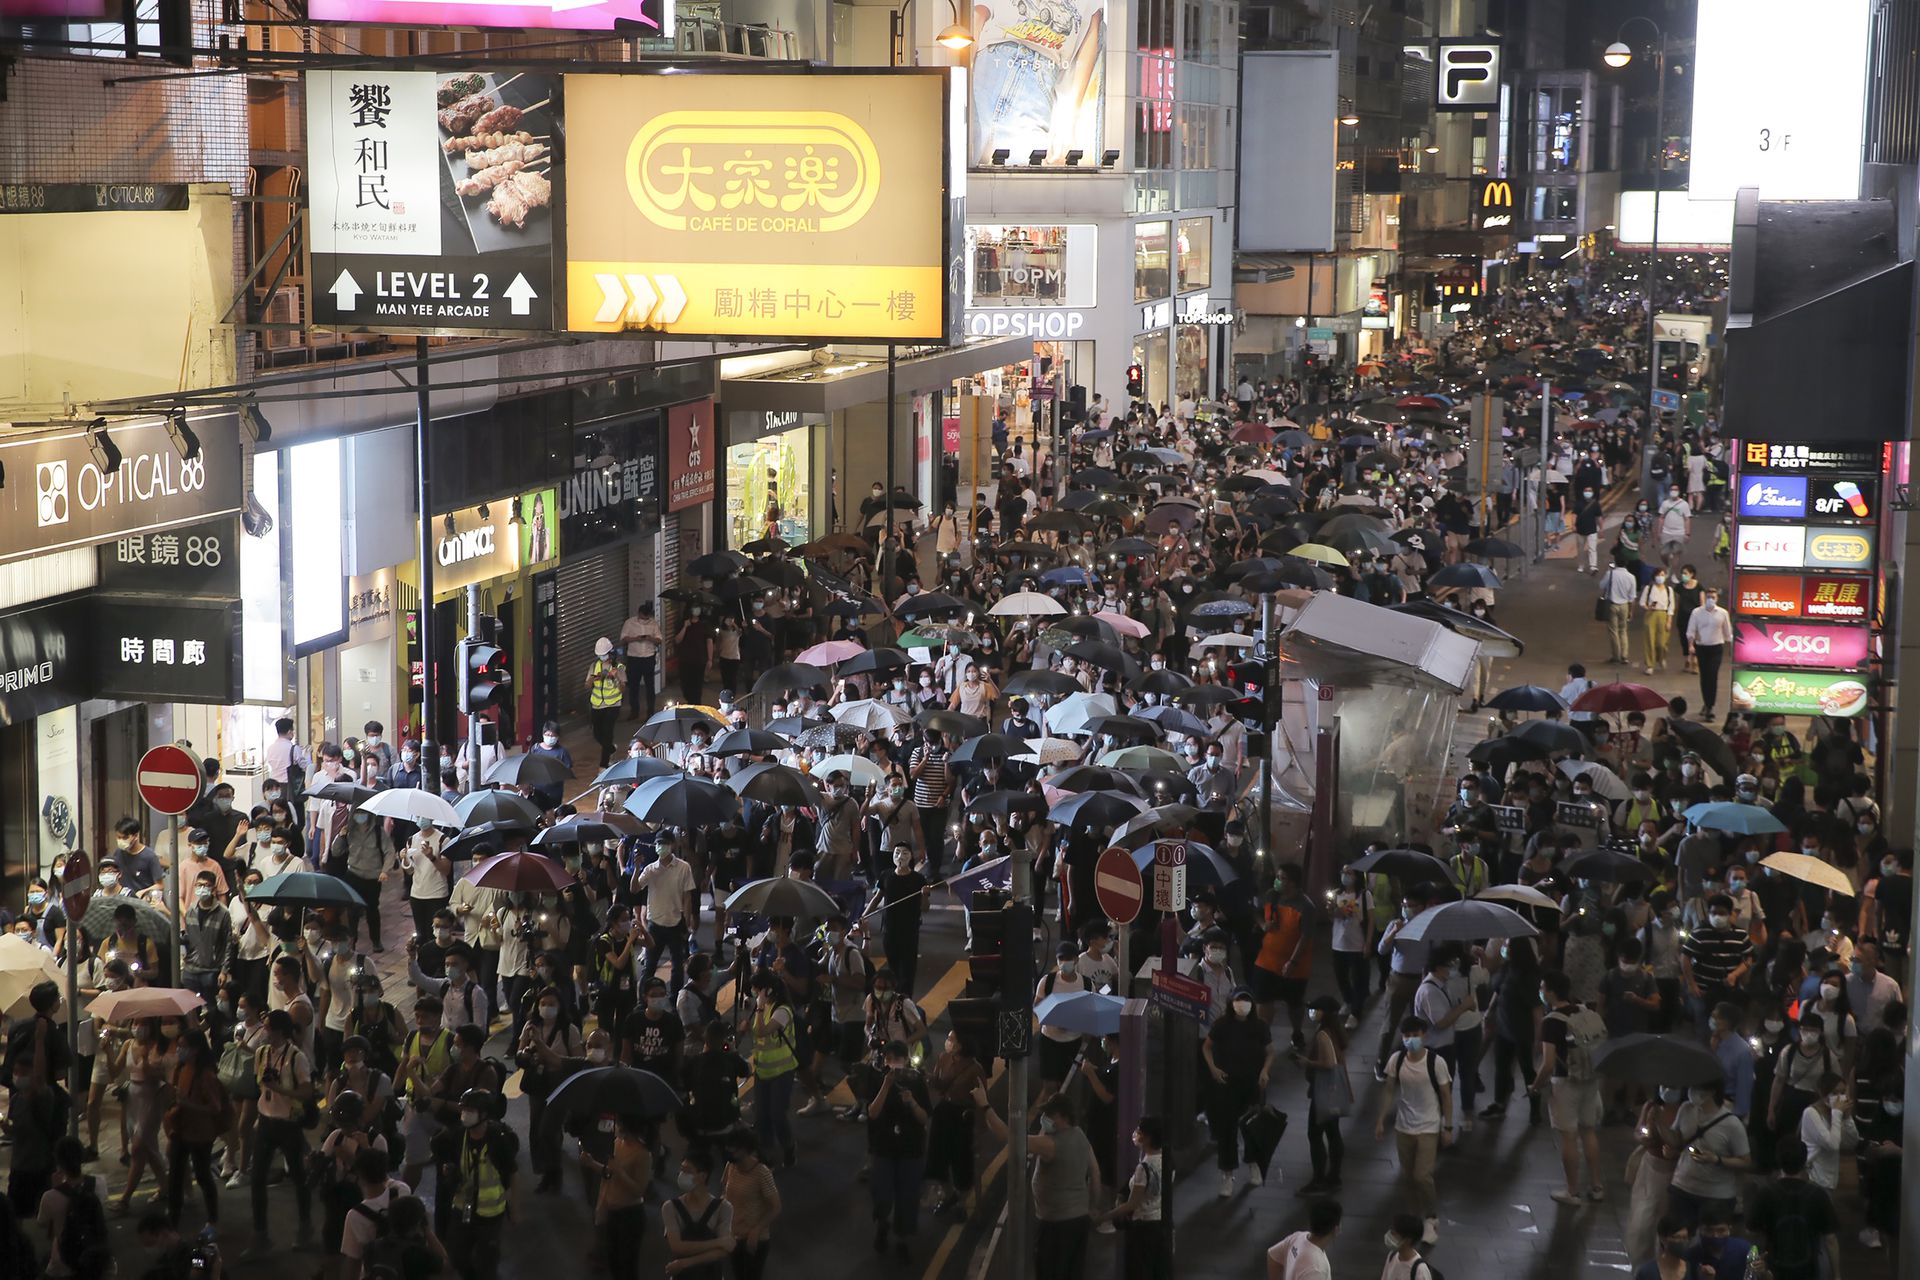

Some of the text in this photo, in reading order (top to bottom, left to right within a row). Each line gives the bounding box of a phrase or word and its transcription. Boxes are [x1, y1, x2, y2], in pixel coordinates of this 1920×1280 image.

[690, 214, 818, 232] CAFÉ DE CORAL
[375, 272, 489, 299] LEVEL 2
[376, 302, 490, 317] MAN YEE ARCADE
[713, 287, 917, 321] 勵精中心一樓
[1176, 313, 1233, 325] TOPSHOP
[1770, 458, 1809, 468] FOOT
[77, 446, 206, 511] OPTICAL 88
[1815, 498, 1845, 513] 8/F
[1742, 598, 1795, 612] mannings
[1807, 602, 1865, 616] wellcome
[121, 637, 207, 665] 時間廊
[1155, 870, 1171, 908] 中環
